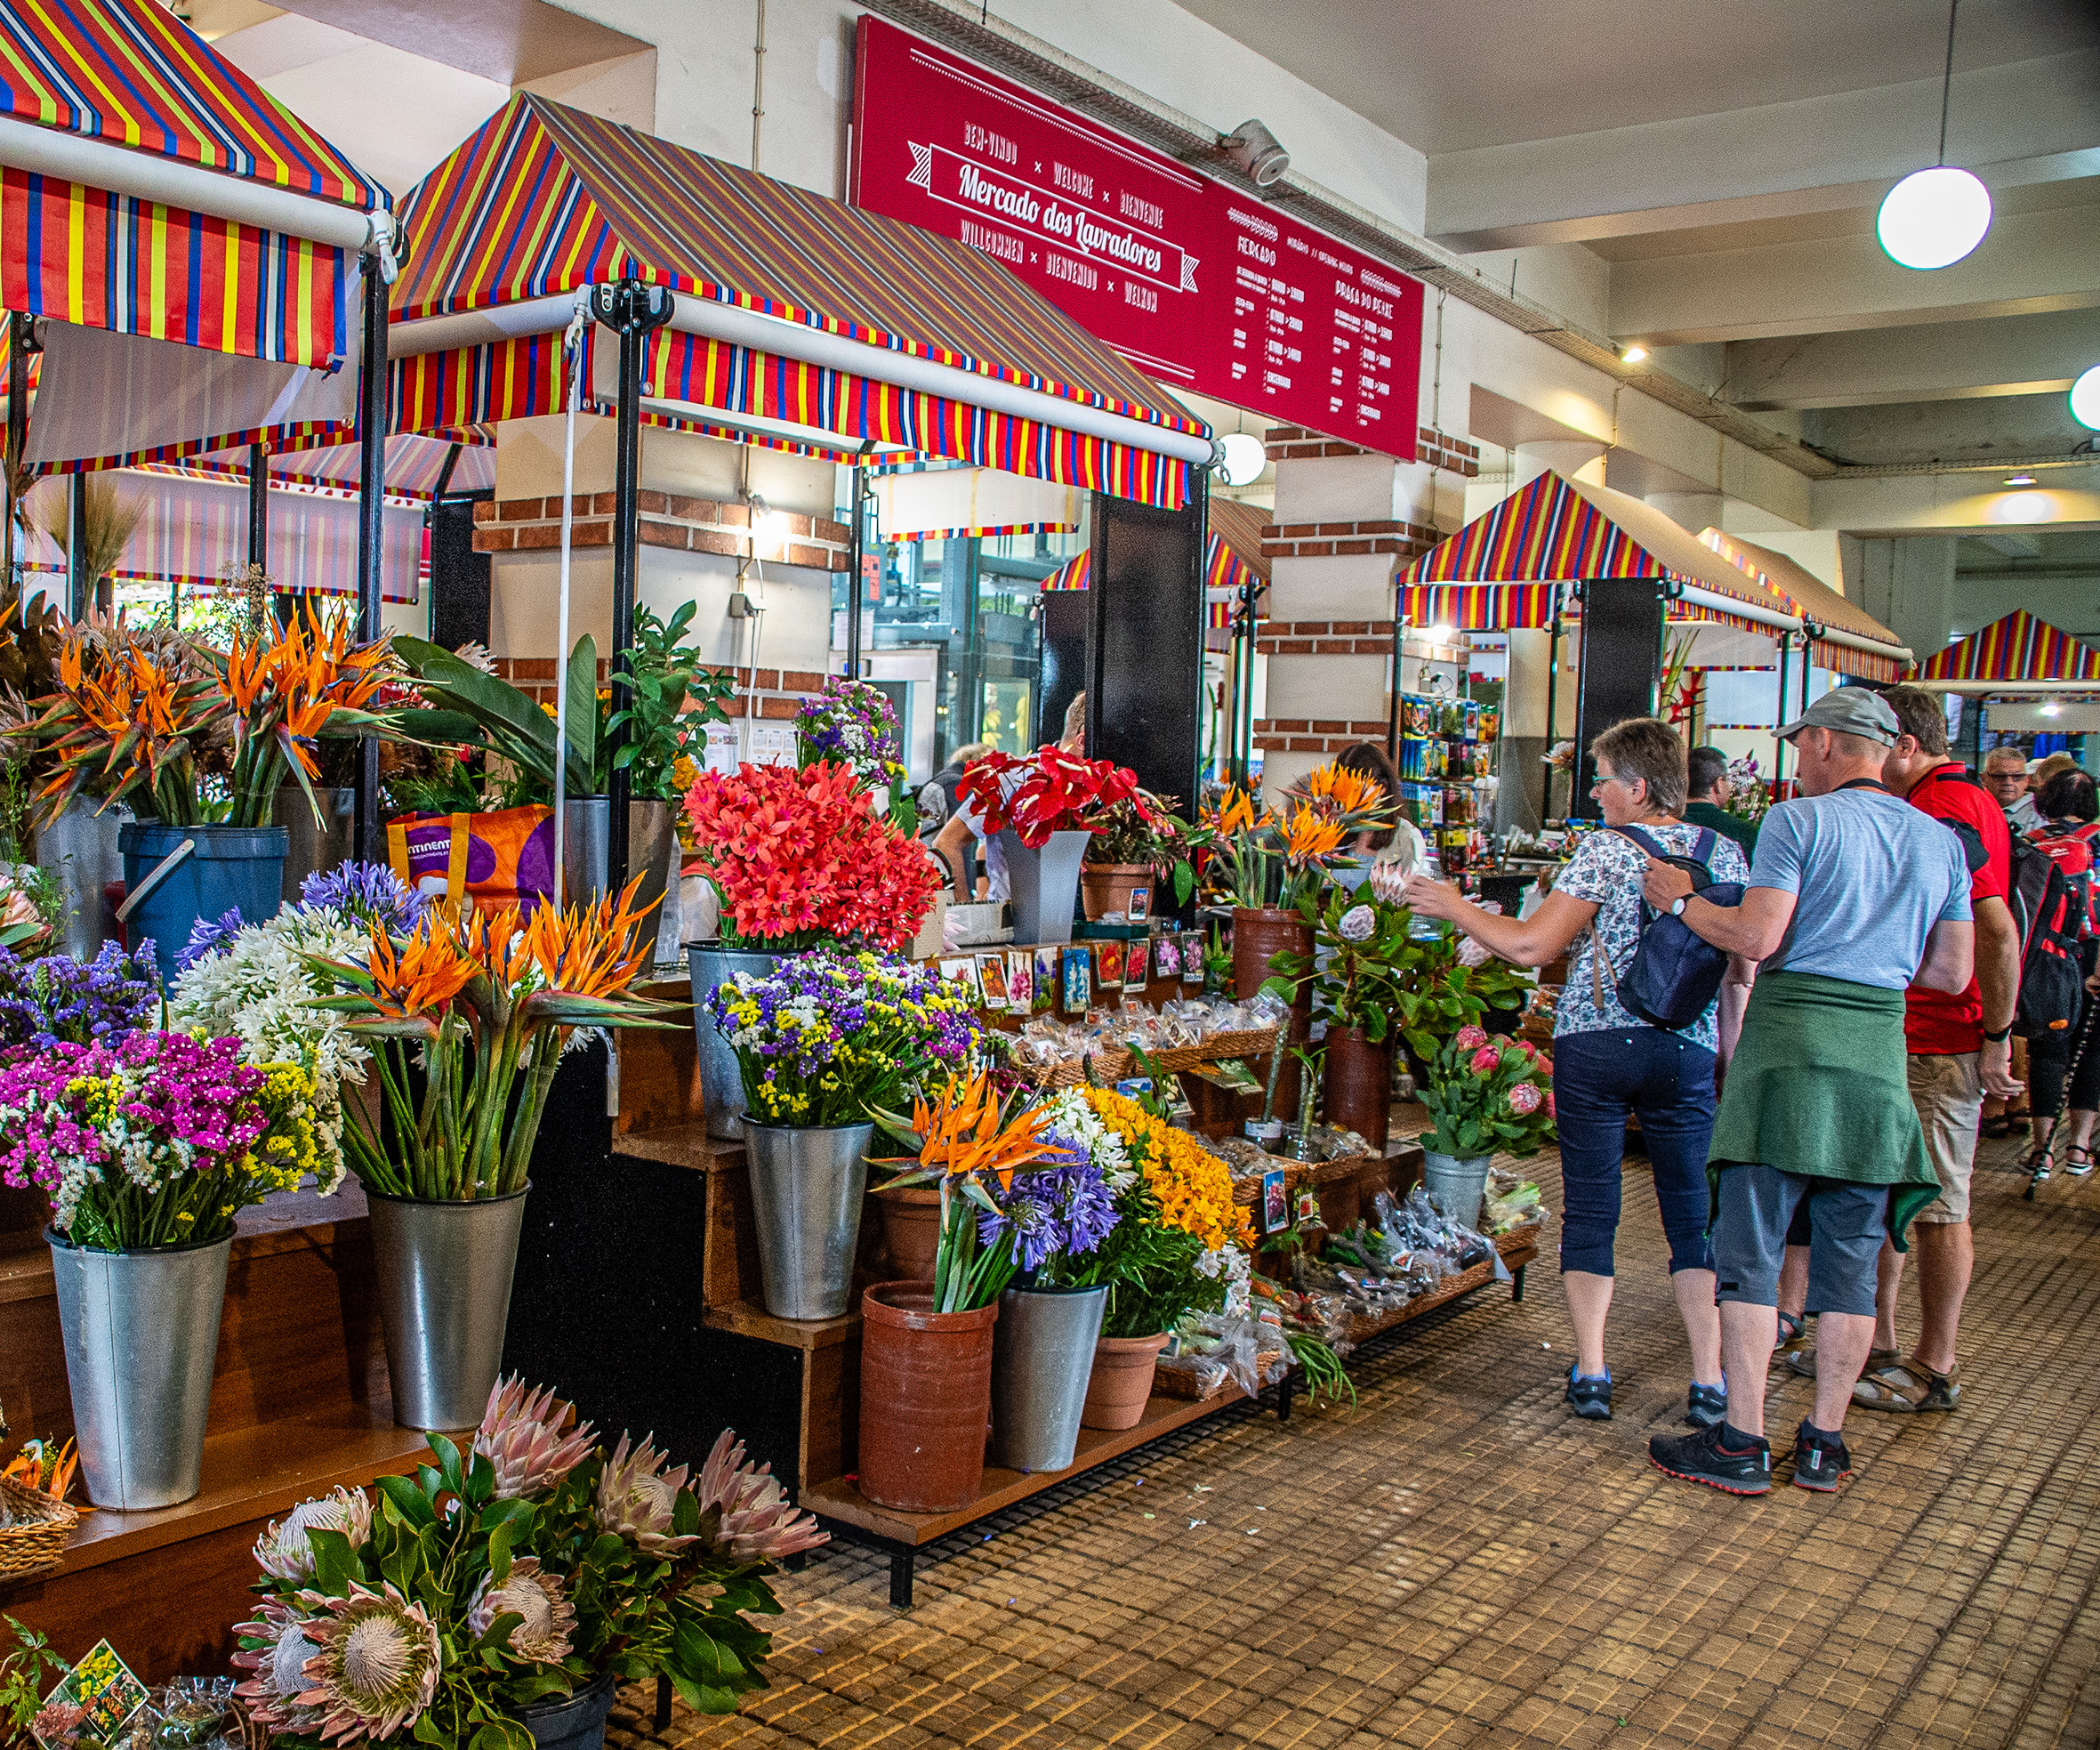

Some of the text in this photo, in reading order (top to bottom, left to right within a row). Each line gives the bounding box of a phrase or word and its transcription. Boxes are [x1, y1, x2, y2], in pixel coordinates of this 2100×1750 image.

[964, 120, 1163, 230] BEM-VINDO WELCOME BIENVENUE
[958, 164, 1162, 272] Mercado dos Lavradores
[1045, 250, 1098, 291] BIENVENIDO
[1237, 235, 1276, 267] MERCADO
[1360, 292, 1372, 310] DO
[1372, 296, 1394, 320] PEIXE
